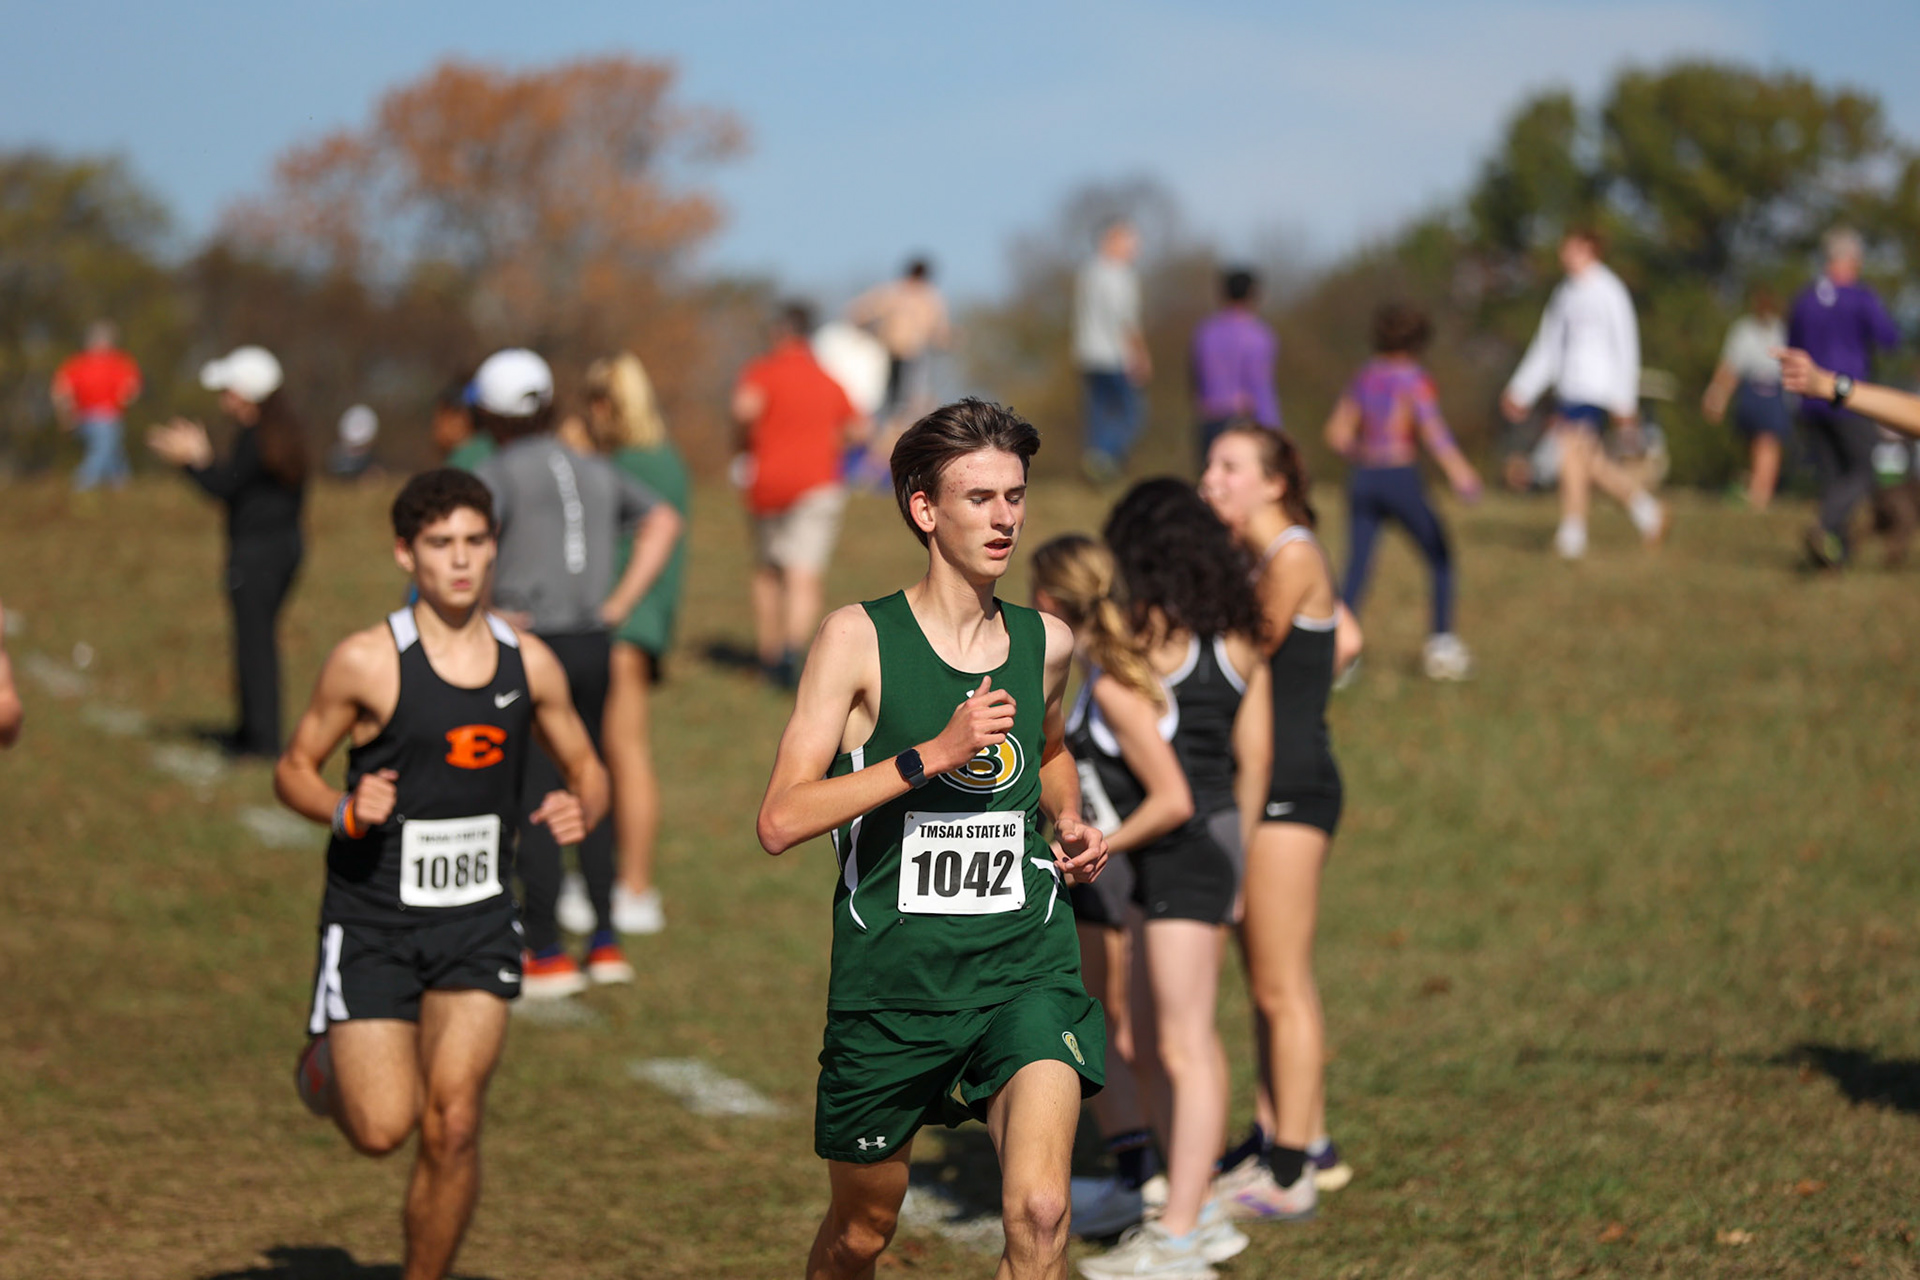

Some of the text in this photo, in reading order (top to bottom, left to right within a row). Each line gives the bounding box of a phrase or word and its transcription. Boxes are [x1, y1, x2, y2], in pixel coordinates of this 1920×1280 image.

[446, 724, 507, 768] E
[919, 823, 1016, 838] TMSAA STATE XC
[412, 850, 489, 889] 1086
[912, 850, 1014, 897] 1042
